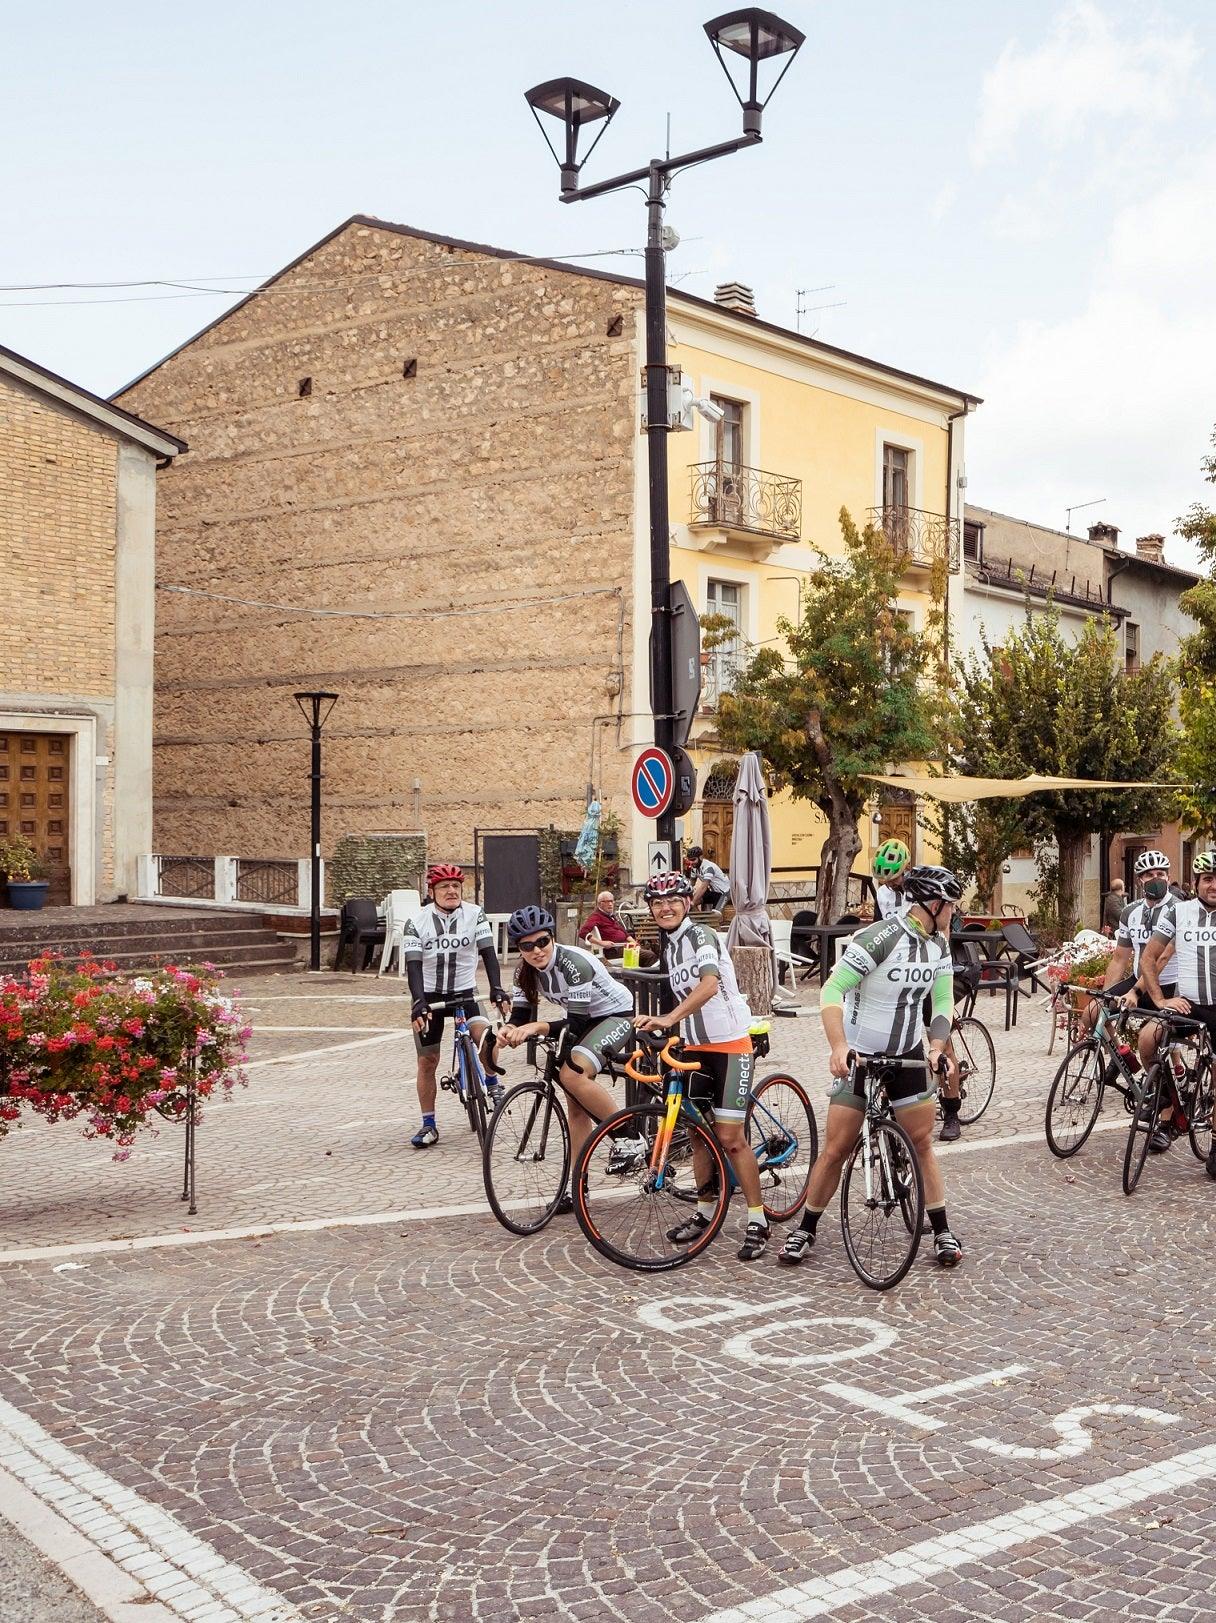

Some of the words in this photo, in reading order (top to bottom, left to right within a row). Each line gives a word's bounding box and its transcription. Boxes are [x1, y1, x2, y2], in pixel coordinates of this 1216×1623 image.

[873, 922, 899, 945] enecta
[562, 957, 581, 984] enecta
[636, 1296, 1182, 1461] STOP
